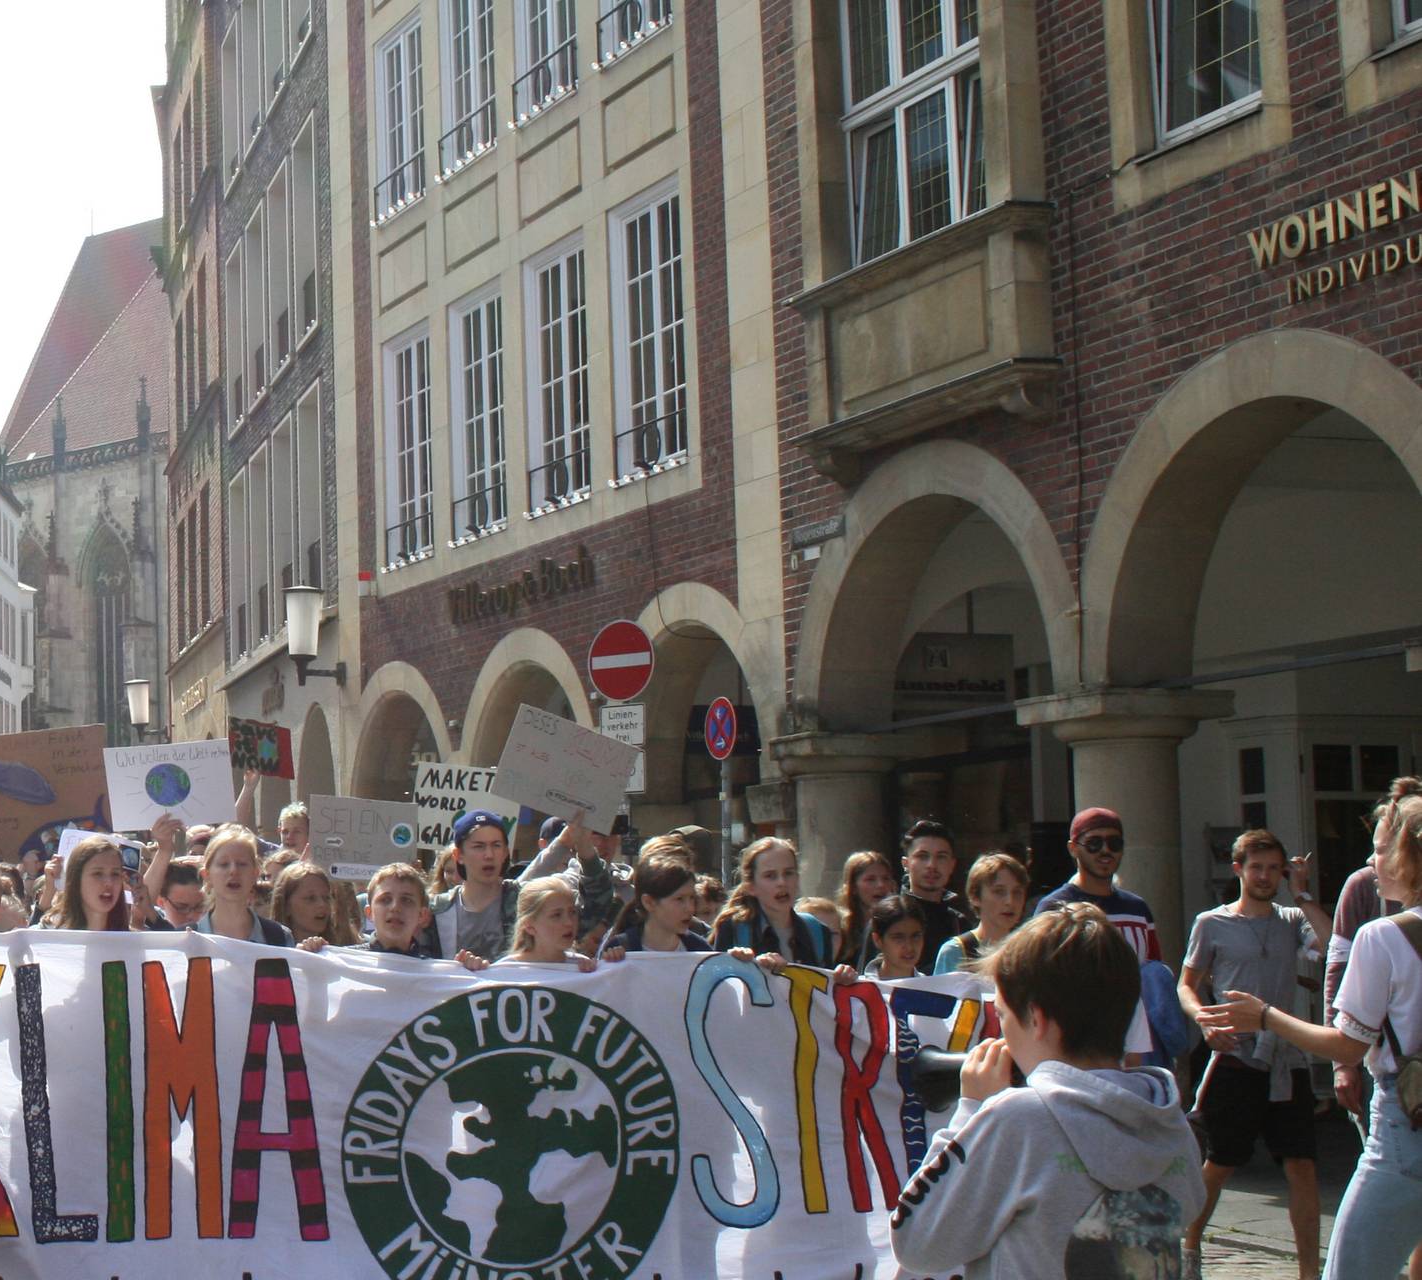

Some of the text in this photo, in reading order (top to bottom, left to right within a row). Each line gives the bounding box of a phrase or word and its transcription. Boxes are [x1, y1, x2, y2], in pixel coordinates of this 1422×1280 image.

[1247, 169, 1422, 271] WOHNEN
[608, 710, 637, 720] Linien-
[607, 721, 638, 731] verkehr
[421, 768, 482, 791] MAKE
[415, 792, 467, 811] WORLD
[344, 988, 676, 1184] FRIDAYS FOR FUTURE
